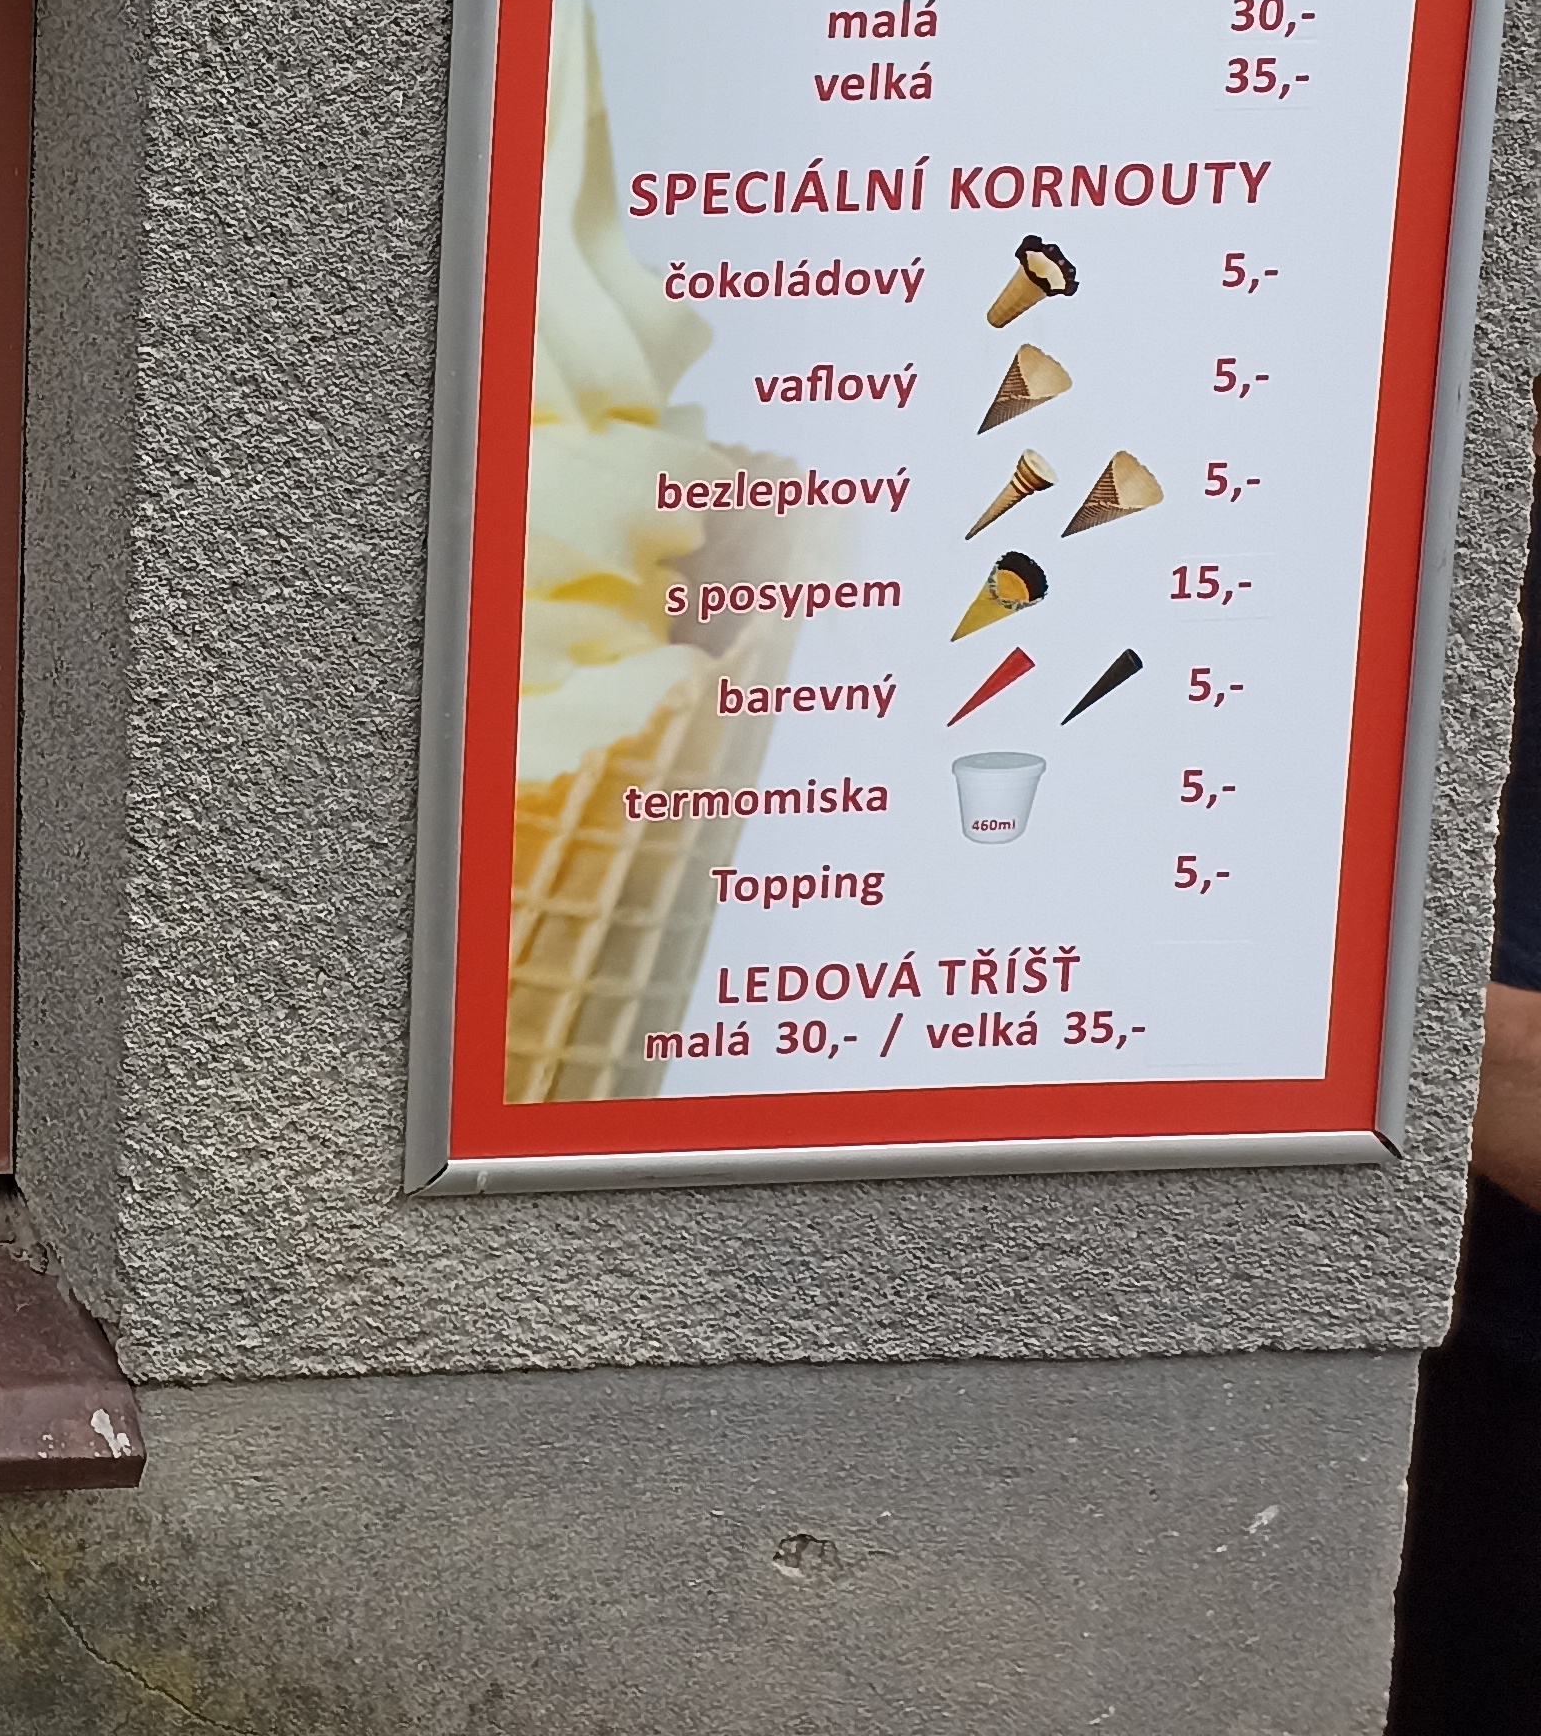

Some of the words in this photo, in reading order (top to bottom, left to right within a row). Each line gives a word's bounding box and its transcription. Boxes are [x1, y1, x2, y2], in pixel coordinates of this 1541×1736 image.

[828, 0, 937, 38] malá
[815, 62, 932, 101] velká
[1226, 58, 1309, 99] 35,-
[630, 156, 929, 216] SPECIÁLNÍ
[951, 162, 1271, 209] KORNOUTY
[666, 257, 924, 303] čokoládový
[1223, 253, 1278, 293] 5,-
[755, 363, 917, 408] vaflový
[1214, 358, 1269, 398] 5,-
[658, 467, 910, 514] bezlepkový
[1205, 463, 1260, 502] 5,-
[667, 586, 688, 616] s
[701, 581, 901, 621] posypem
[1171, 566, 1251, 605] 15,-
[720, 674, 896, 718] barevný
[1189, 668, 1243, 707] 5,-
[624, 778, 889, 819] termomiska
[1181, 770, 1235, 809] 5,-
[972, 819, 1016, 831] 460ml
[712, 865, 884, 909] Topping
[1175, 856, 1229, 894] 5,-
[719, 951, 921, 1003] LEDOVÁ
[938, 946, 1080, 995] TŘÍŠŤ
[645, 1021, 750, 1059] malá
[776, 1021, 857, 1059] 30,-
[880, 1013, 903, 1057] /
[927, 1011, 1037, 1048] velká
[1064, 1011, 1145, 1049] 35,-
